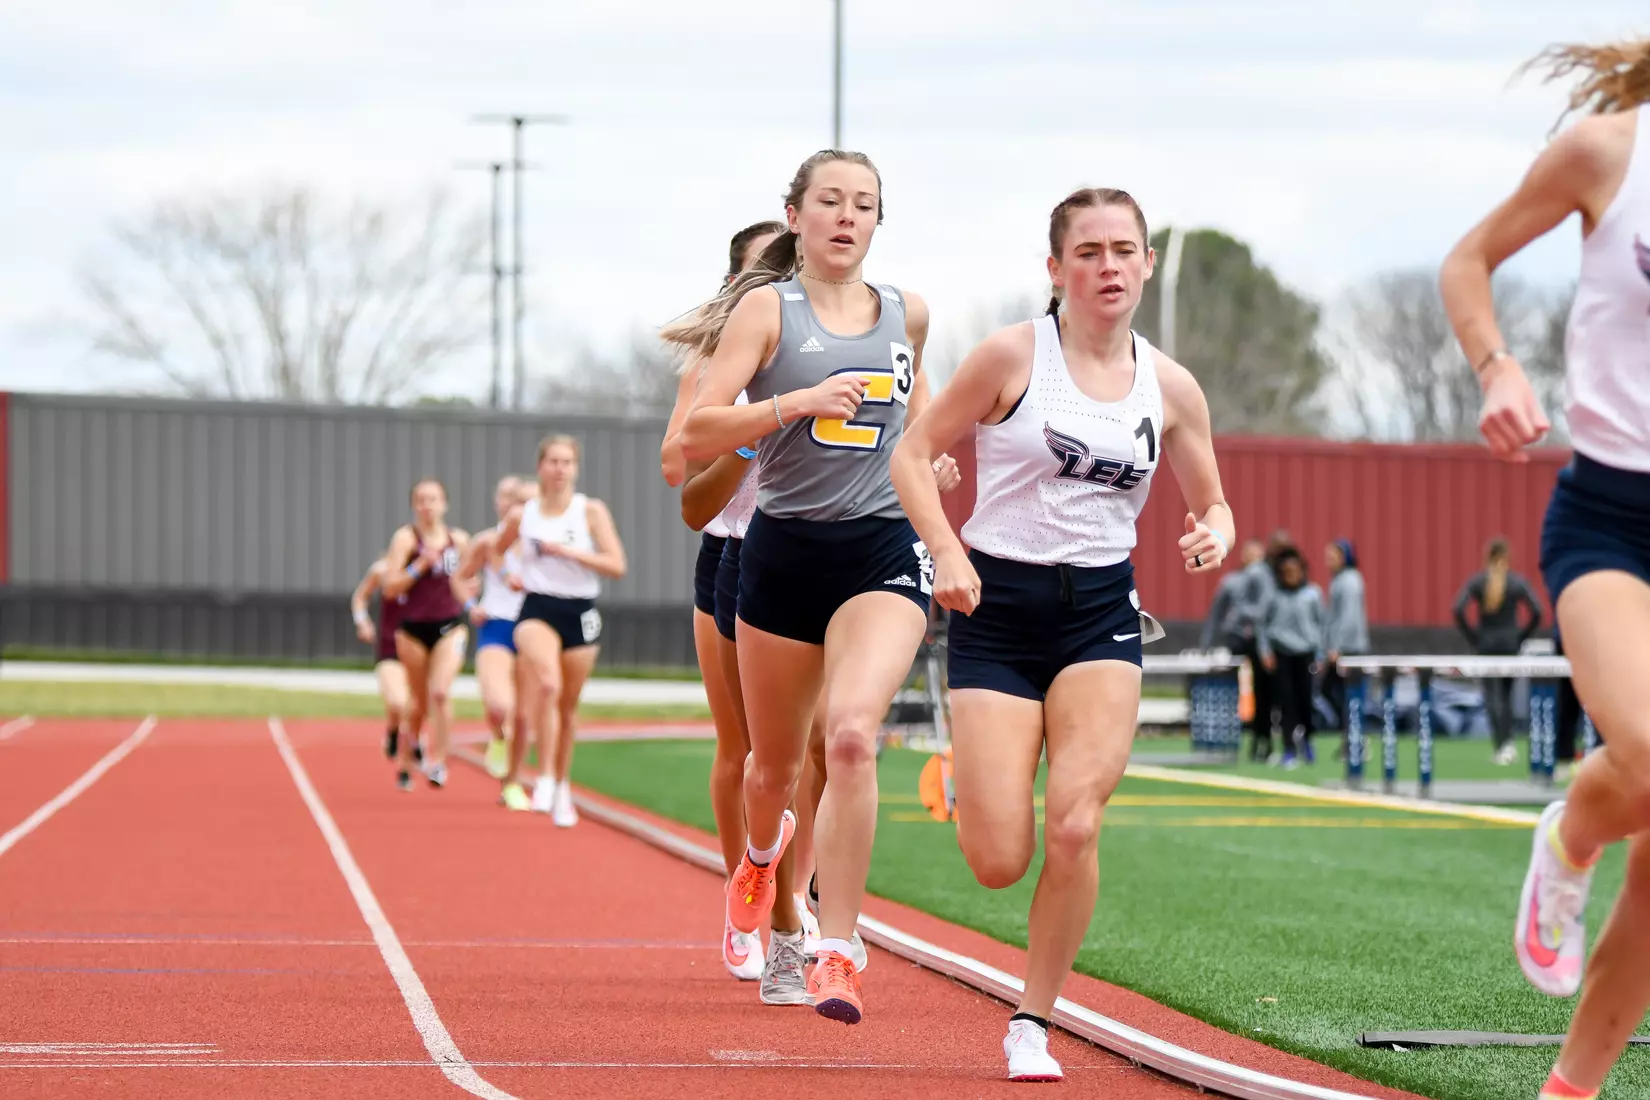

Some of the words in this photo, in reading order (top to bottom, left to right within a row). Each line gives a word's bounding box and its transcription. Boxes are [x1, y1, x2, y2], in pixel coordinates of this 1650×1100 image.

[896, 353, 912, 395] 3
[1134, 416, 1155, 462] 1
[1054, 451, 1150, 492] LEE
[883, 577, 917, 587] adidas
